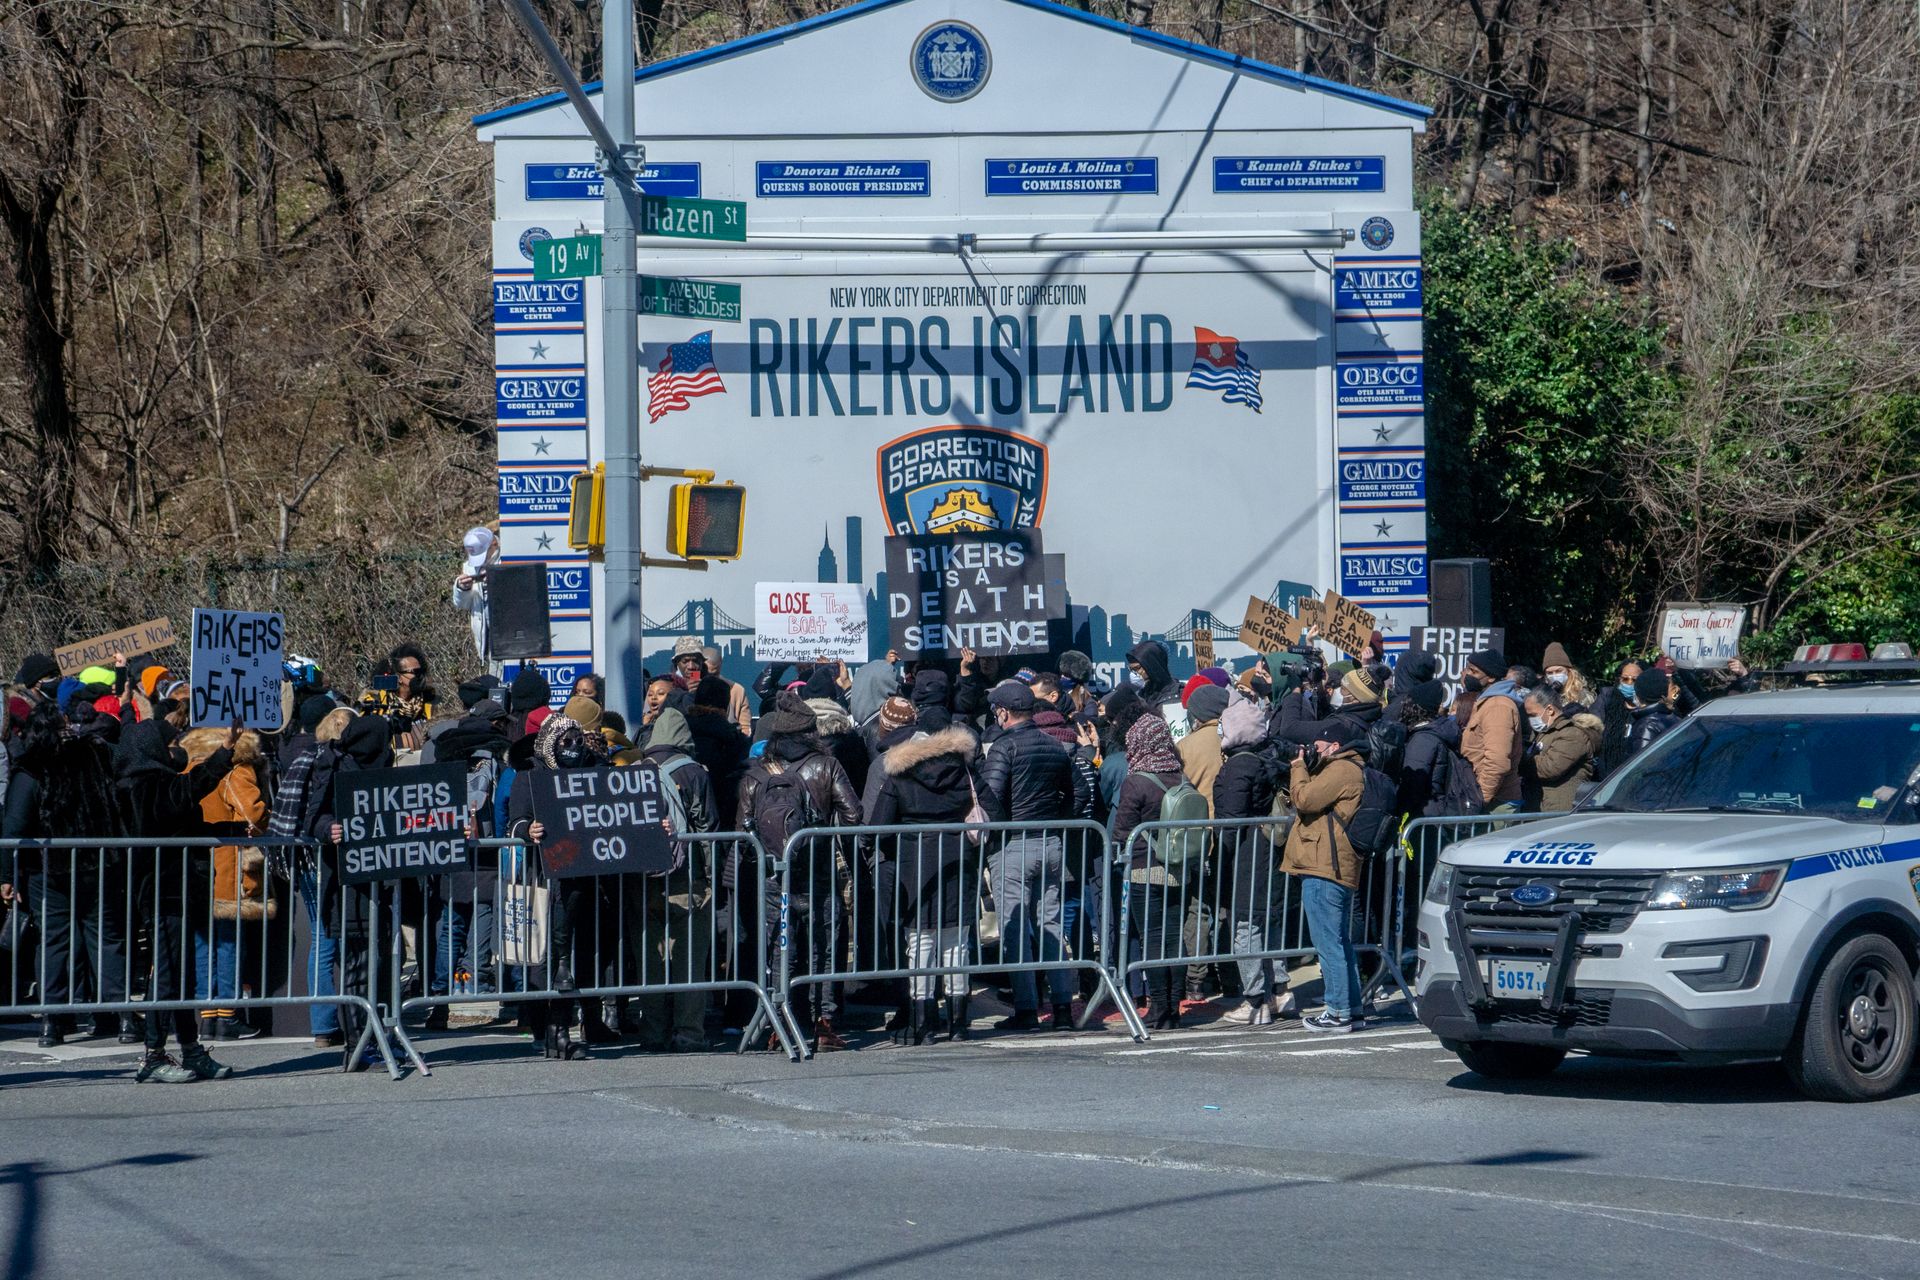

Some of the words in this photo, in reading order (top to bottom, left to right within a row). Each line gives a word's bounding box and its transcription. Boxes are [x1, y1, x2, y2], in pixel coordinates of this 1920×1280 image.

[566, 168, 595, 178] Eric
[784, 166, 839, 176] Donovan
[844, 166, 901, 176] Richards
[1020, 162, 1056, 174] Louis
[1058, 162, 1073, 173] A.
[1076, 162, 1122, 172] Molina
[1247, 160, 1303, 172] Kenneth
[1307, 160, 1351, 171] Stukes
[762, 182, 804, 192] QUEENS
[808, 182, 860, 192] BOROUGH
[864, 182, 925, 191] PRESIDENT
[1022, 180, 1122, 190] COMMISSIONER
[1240, 178, 1273, 186] CHIEF
[1274, 177, 1285, 186] of
[1286, 176, 1360, 186] DEPARTMENT
[647, 201, 714, 234] Hazen
[724, 206, 738, 225] St
[548, 244, 568, 274] 19
[575, 242, 589, 262] Av
[1341, 270, 1417, 288] AMKC
[496, 283, 578, 302] EMTC
[668, 282, 716, 300] AVENUE
[830, 287, 857, 308] NEW
[860, 287, 892, 308] YORK
[894, 286, 920, 307] CITY
[922, 286, 998, 307] DEPARTMENT
[1000, 285, 1014, 306] OF
[1018, 284, 1086, 306] CORRECTION
[1383, 292, 1406, 300] KROSS
[642, 296, 658, 310] OF
[662, 296, 688, 313] THE
[688, 298, 741, 318] BOLDEST
[749, 314, 952, 418] RIKERS
[973, 312, 1174, 416] ISLAND
[1343, 366, 1418, 386] OBCC
[500, 379, 580, 398] GRVC
[1376, 388, 1405, 396] BANTUM
[889, 437, 1036, 473] CORRECTION
[889, 458, 1036, 494] DEPARTMENT
[1343, 462, 1422, 481] GMDC
[905, 542, 1025, 574] RIKERS
[1346, 557, 1424, 576] RMSC
[936, 570, 960, 588] IS
[975, 568, 991, 585] A
[769, 592, 812, 614] CLOSE
[890, 584, 1044, 618] DEATH
[1261, 602, 1292, 625] FREE
[1333, 614, 1345, 626] IS
[1348, 622, 1357, 635] A
[1335, 597, 1376, 631] RIKERS
[198, 613, 281, 658] RIKERS
[904, 620, 1049, 652] SENTENCE
[1244, 619, 1297, 647] NEIGHBO
[1264, 616, 1287, 635] OUR
[1329, 623, 1364, 649] DEATH
[57, 632, 142, 670] DECARCERATE
[1318, 631, 1363, 660] SENTENC
[1422, 627, 1491, 654] FREE
[222, 652, 231, 666] is
[252, 658, 259, 668] a
[1433, 653, 1468, 680] OU
[192, 668, 258, 723] DEATH
[264, 708, 277, 722] Ce
[554, 772, 598, 799] LET
[607, 770, 658, 794] OUR
[354, 782, 450, 816] RIKERS
[342, 816, 366, 842] IS
[371, 814, 386, 838] A
[396, 804, 469, 836] DEATH
[566, 800, 660, 831] PEOPLE
[345, 838, 466, 874] SENTENCE
[592, 836, 627, 861] GO
[1528, 842, 1596, 850] NYPD
[1503, 850, 1598, 866] POLICE
[1829, 847, 1884, 870] POLICE
[1518, 888, 1543, 900] Ford
[1498, 970, 1535, 990] 5057
